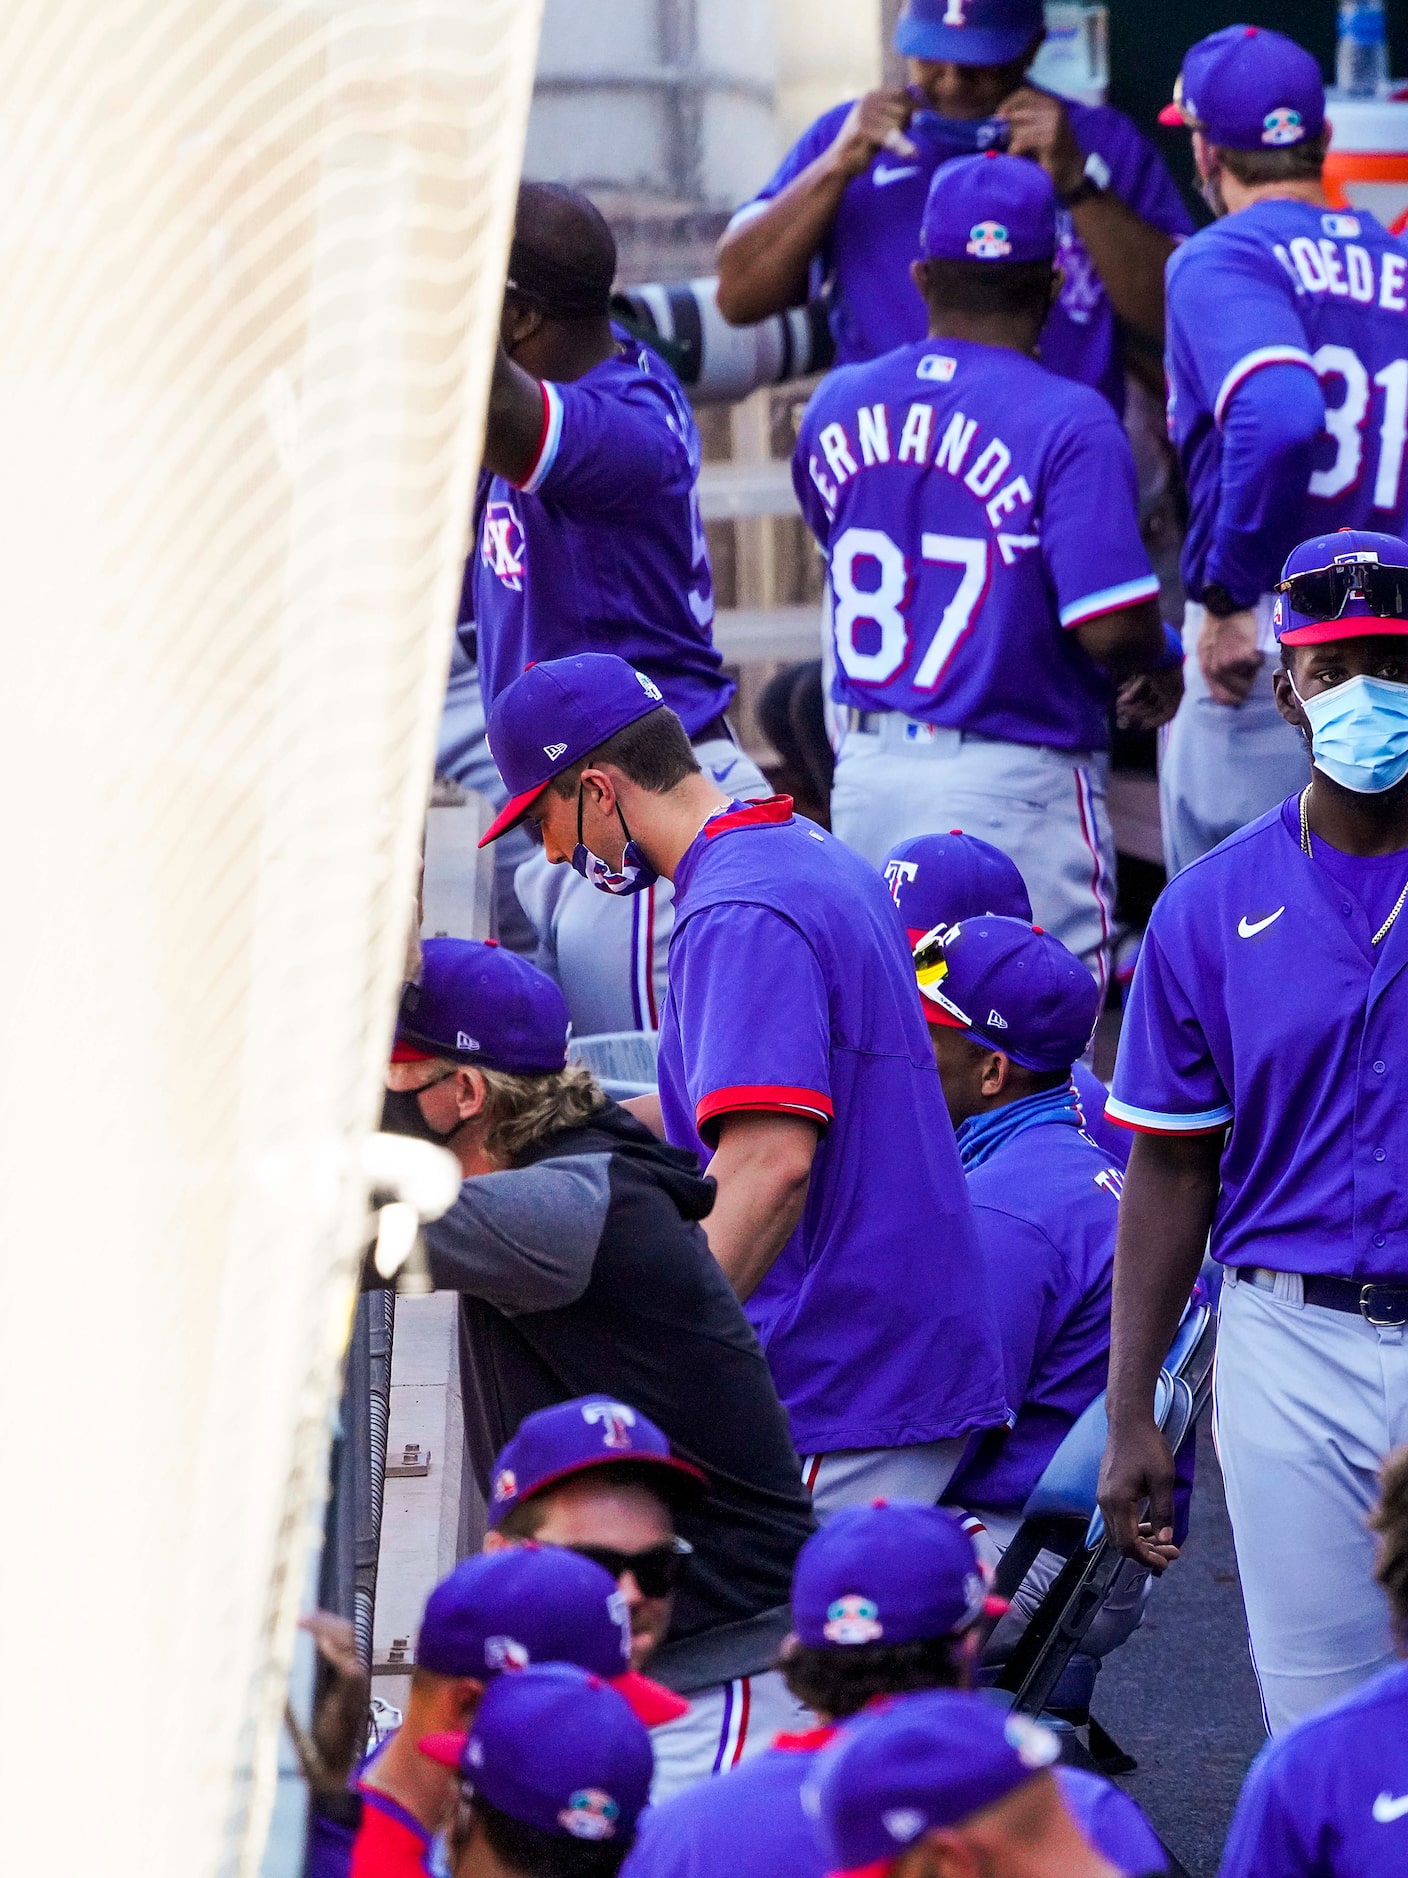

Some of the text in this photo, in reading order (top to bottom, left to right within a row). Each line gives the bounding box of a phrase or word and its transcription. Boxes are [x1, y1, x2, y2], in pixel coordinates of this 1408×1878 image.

[809, 402, 1041, 566] ERNANDEZ
[831, 527, 990, 694] 87
[883, 859, 919, 908] T
[581, 1401, 636, 1449] T
